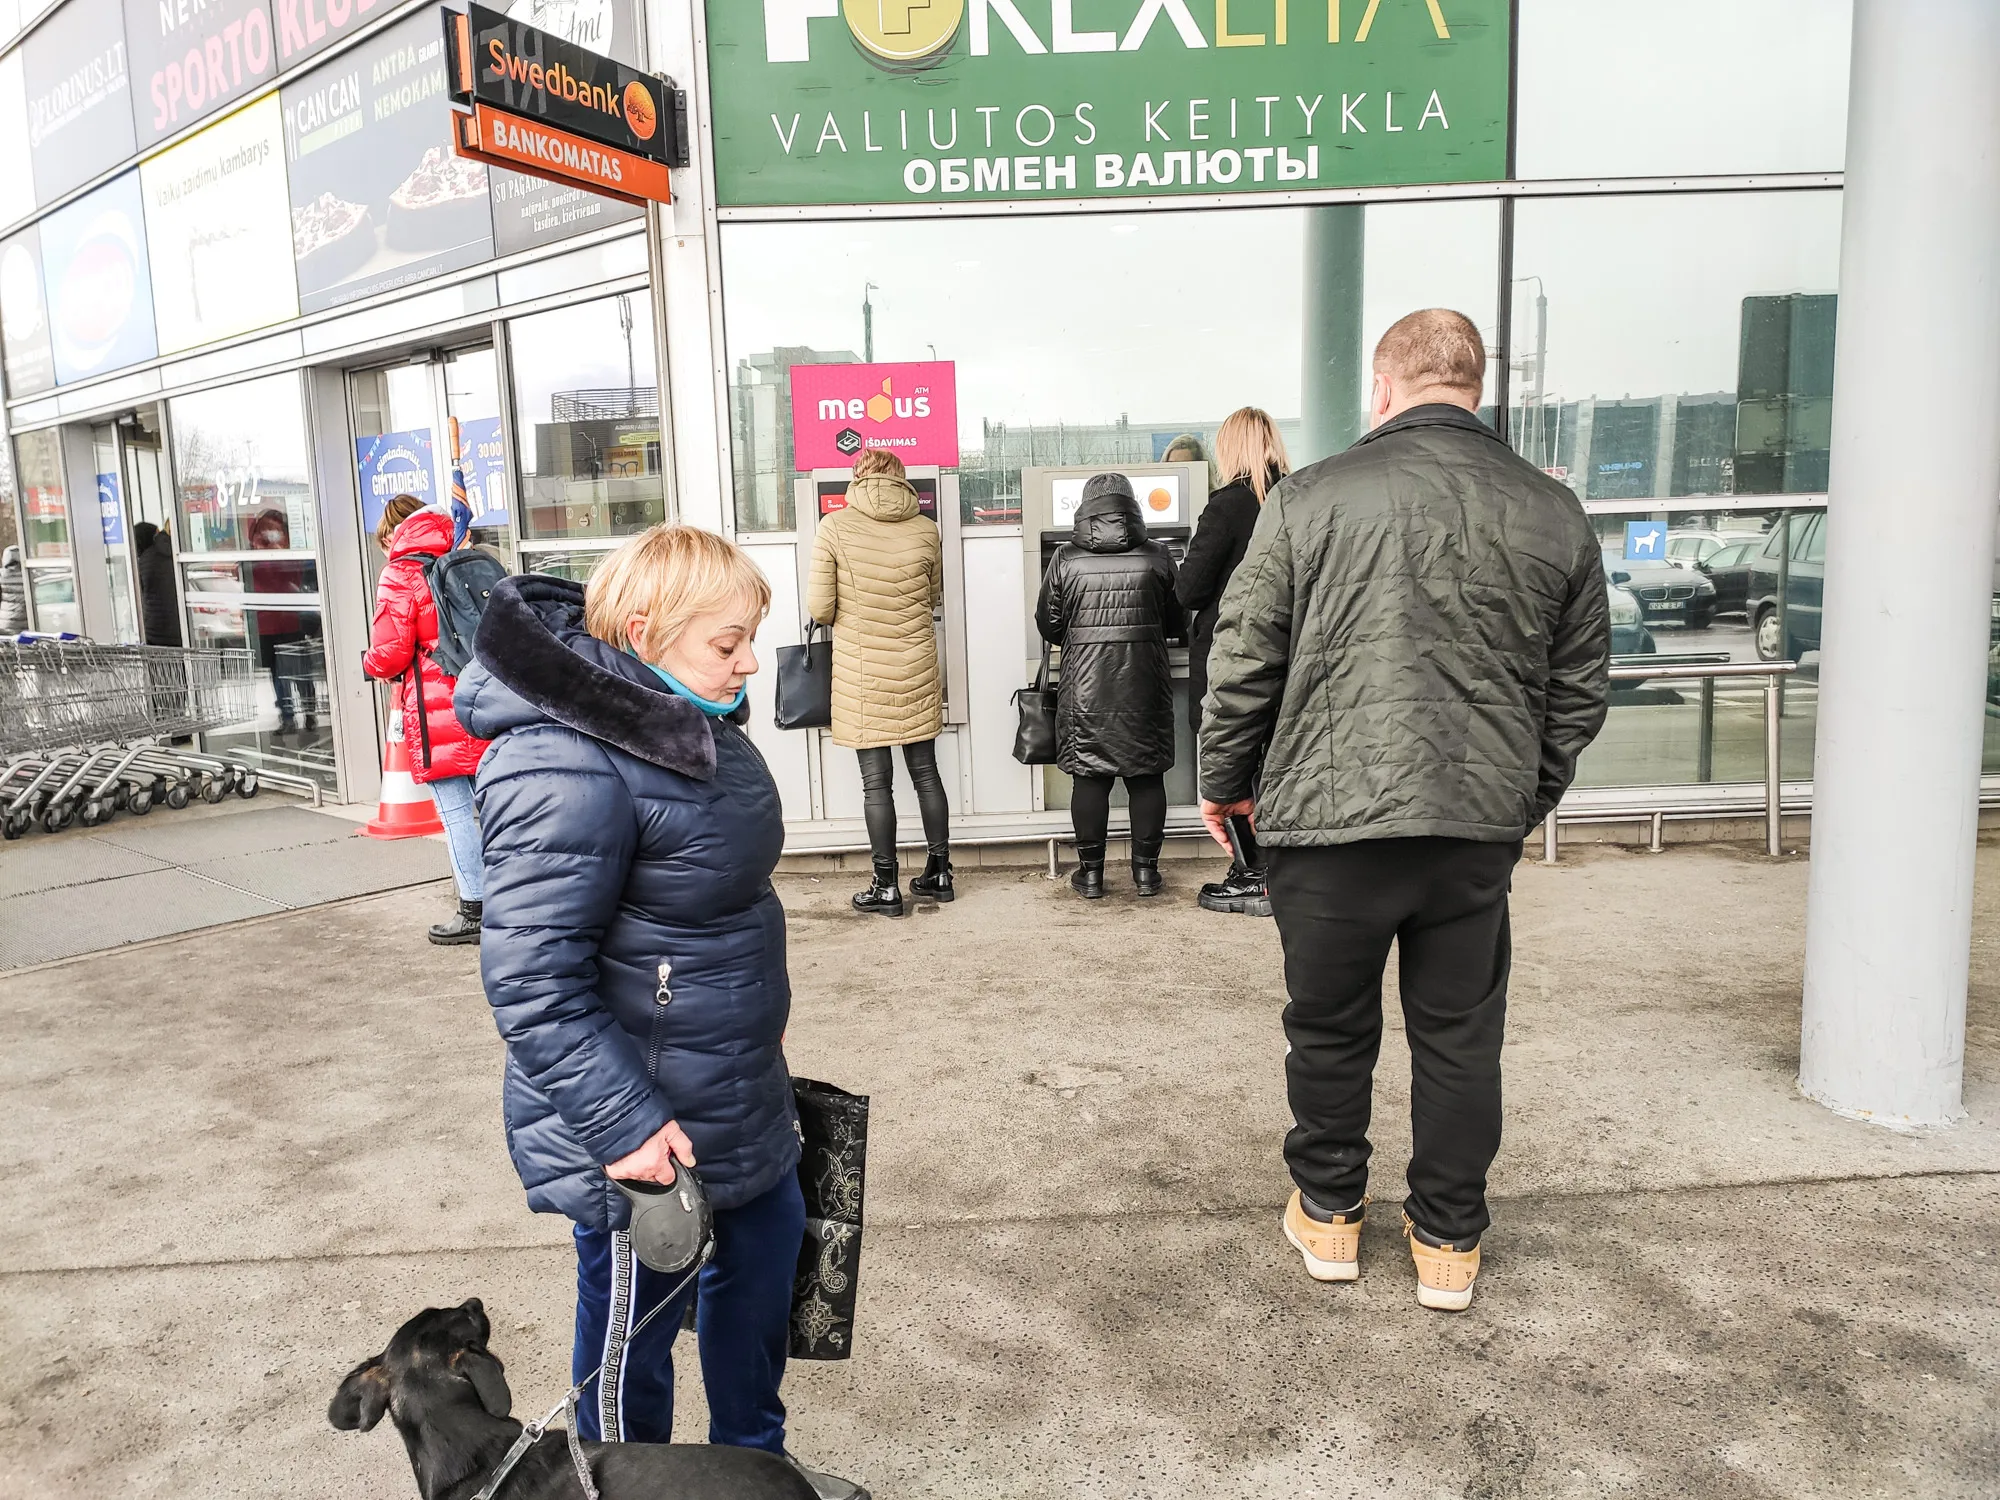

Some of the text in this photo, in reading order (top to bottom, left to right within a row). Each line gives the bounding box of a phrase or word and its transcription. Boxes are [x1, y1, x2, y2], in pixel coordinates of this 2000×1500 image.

[151, 8, 269, 131] SPORTO
[372, 46, 417, 87] ANTRA
[489, 38, 621, 119] Swedbank
[297, 71, 361, 133] CAN CAN
[770, 89, 1449, 155] VALIUTOS KEITYKLA
[219, 138, 270, 178] kambarys
[493, 119, 622, 182] BANKOMATAS
[903, 145, 1319, 194] ОБМЕН ВАЛЮТЫ
[495, 180, 507, 203] SU
[562, 202, 601, 224] kiekvienam
[865, 436, 917, 447] IŠDAVIMAS
[215, 466, 262, 508] 8-22
[371, 468, 430, 497] GIMTADIENIS
